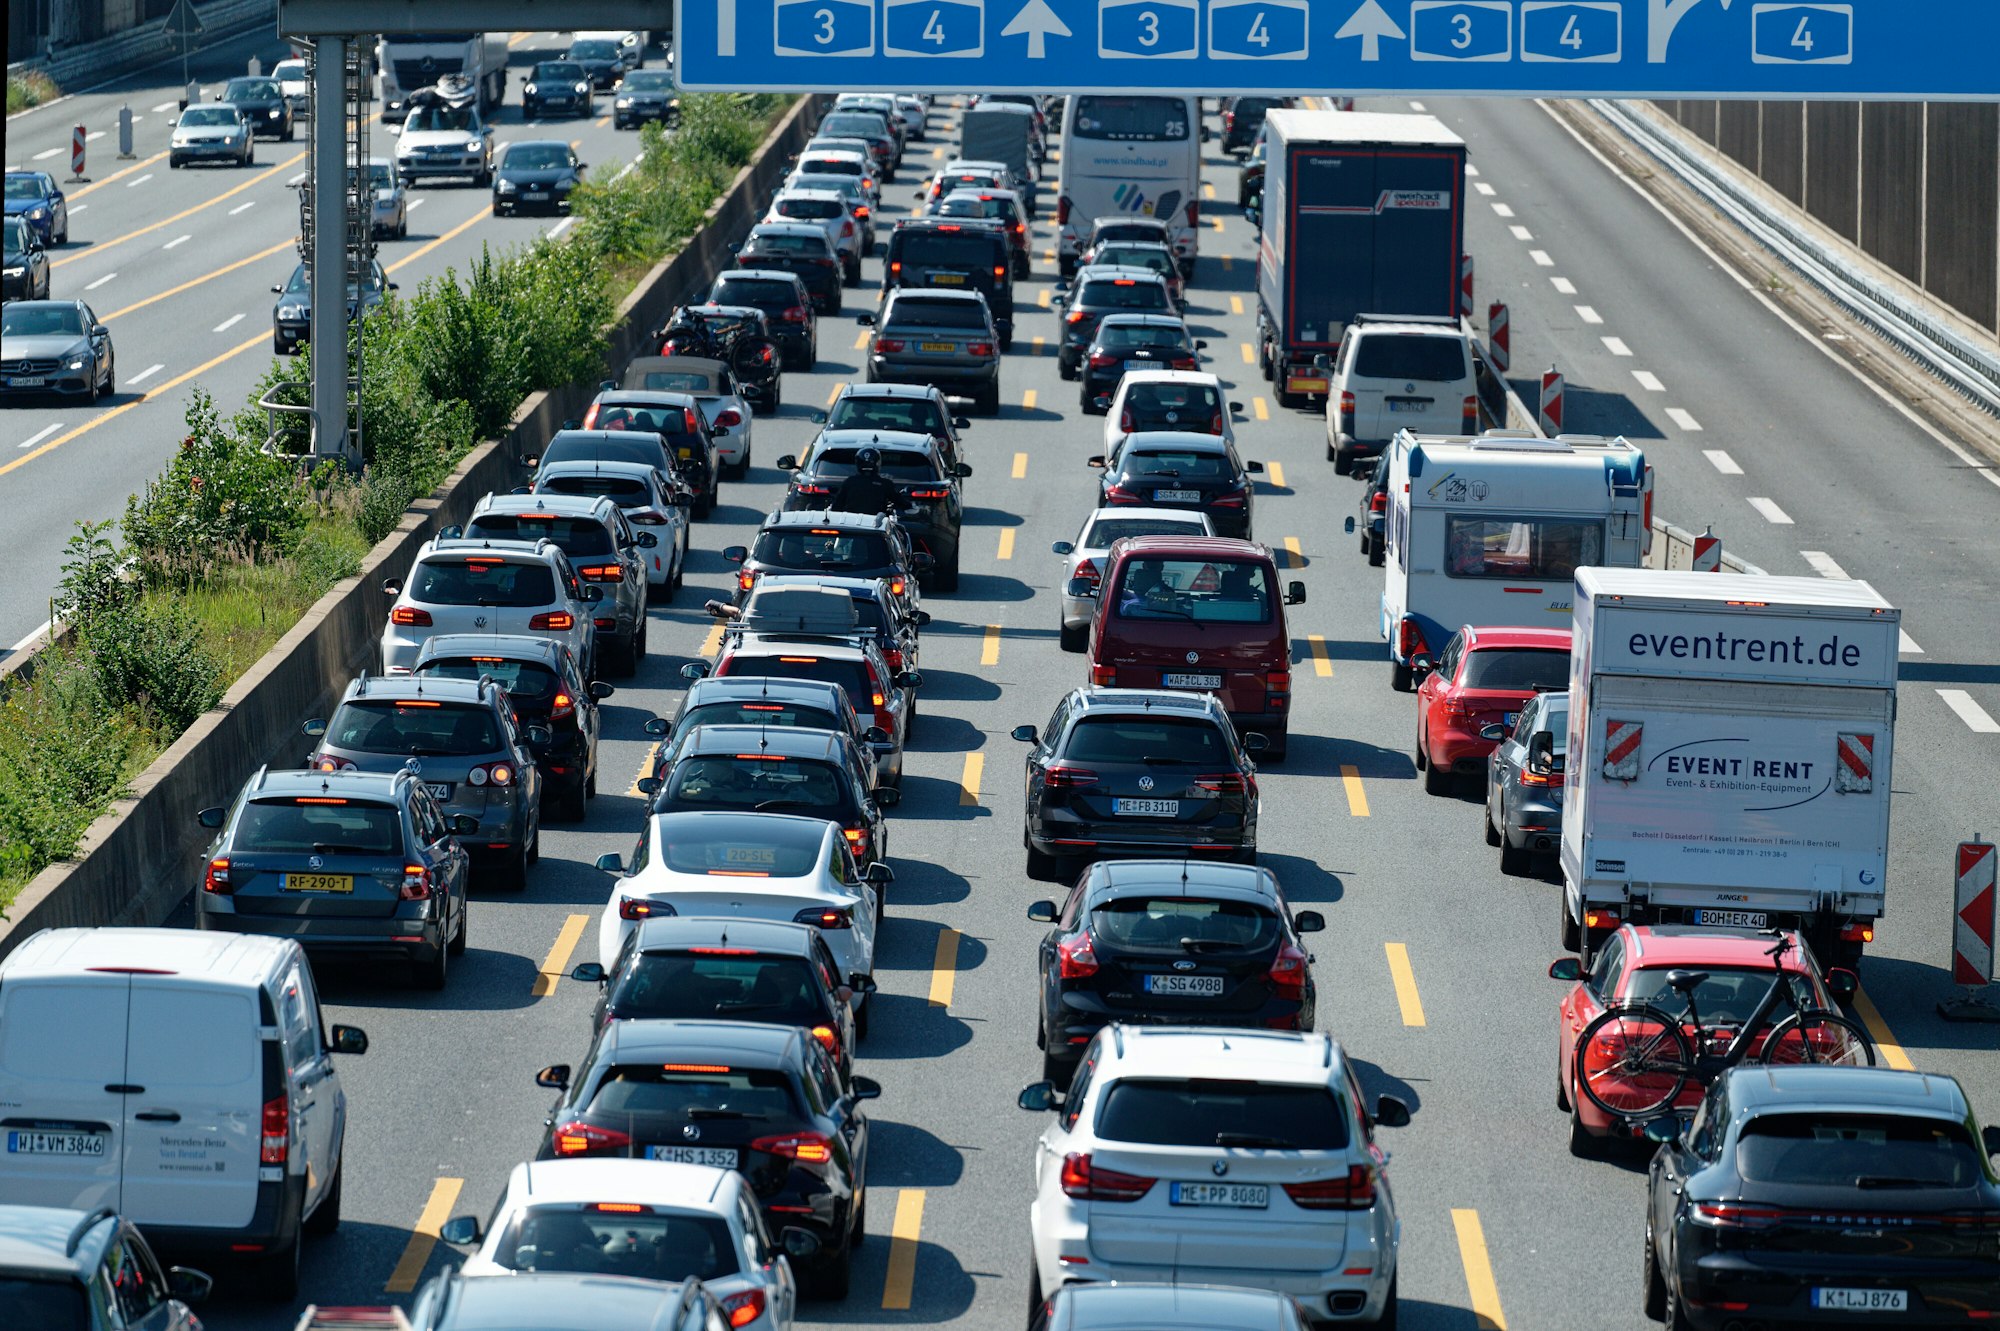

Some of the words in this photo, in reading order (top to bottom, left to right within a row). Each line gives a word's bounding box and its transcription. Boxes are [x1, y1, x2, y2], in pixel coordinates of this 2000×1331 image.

[815, 9, 835, 44] 3
[923, 11, 945, 45] 4
[1139, 12, 1159, 46] 3
[1248, 13, 1270, 47] 4
[1452, 14, 1472, 48] 3
[1560, 15, 1582, 49] 4
[1792, 17, 1814, 51] 4
[1165, 121, 1185, 137] 25
[1629, 632, 1861, 667] eventrent.de
[1169, 675, 1187, 685] WAF
[1191, 676, 1202, 686] CL
[1204, 676, 1220, 687] 383
[1667, 756, 1742, 776] EVENT
[1753, 760, 1813, 779] RENT
[1666, 778, 1696, 788] Event-
[1710, 780, 1811, 794] Exhibition-Equipment
[1119, 800, 1131, 811] ME
[1138, 801, 1151, 812] FB
[1153, 802, 1177, 812] 3110
[1632, 831, 1658, 839] Bocholt
[1664, 832, 1703, 841] Düsseldorf
[1709, 835, 1732, 843] Kassel
[1739, 837, 1773, 845] Heilbronn
[1780, 838, 1801, 846] Berlin
[1807, 840, 1824, 848] Bern
[1682, 846, 1711, 854] Zentrale:
[1596, 861, 1625, 872] Sörensen
[289, 876, 348, 889] RF-290-T
[1702, 912, 1725, 924] BOH
[1733, 913, 1748, 925] ER
[1751, 915, 1766, 926] 40
[1152, 977, 1160, 989] K
[1169, 977, 1186, 990] SG
[1189, 978, 1221, 991] 4988
[19, 1135, 34, 1150] WI
[48, 1136, 64, 1151] VM
[68, 1136, 102, 1153] 3846
[160, 1137, 227, 1147] Mercedes-Benz
[674, 1149, 694, 1163] HS
[698, 1151, 735, 1166] 1352
[1180, 1186, 1198, 1200] ME
[1209, 1187, 1227, 1201] PP
[1810, 1215, 1912, 1226] PORSCHE
[1826, 1290, 1836, 1306] K
[1847, 1291, 1868, 1306] LJ
[1871, 1292, 1900, 1308] 876
